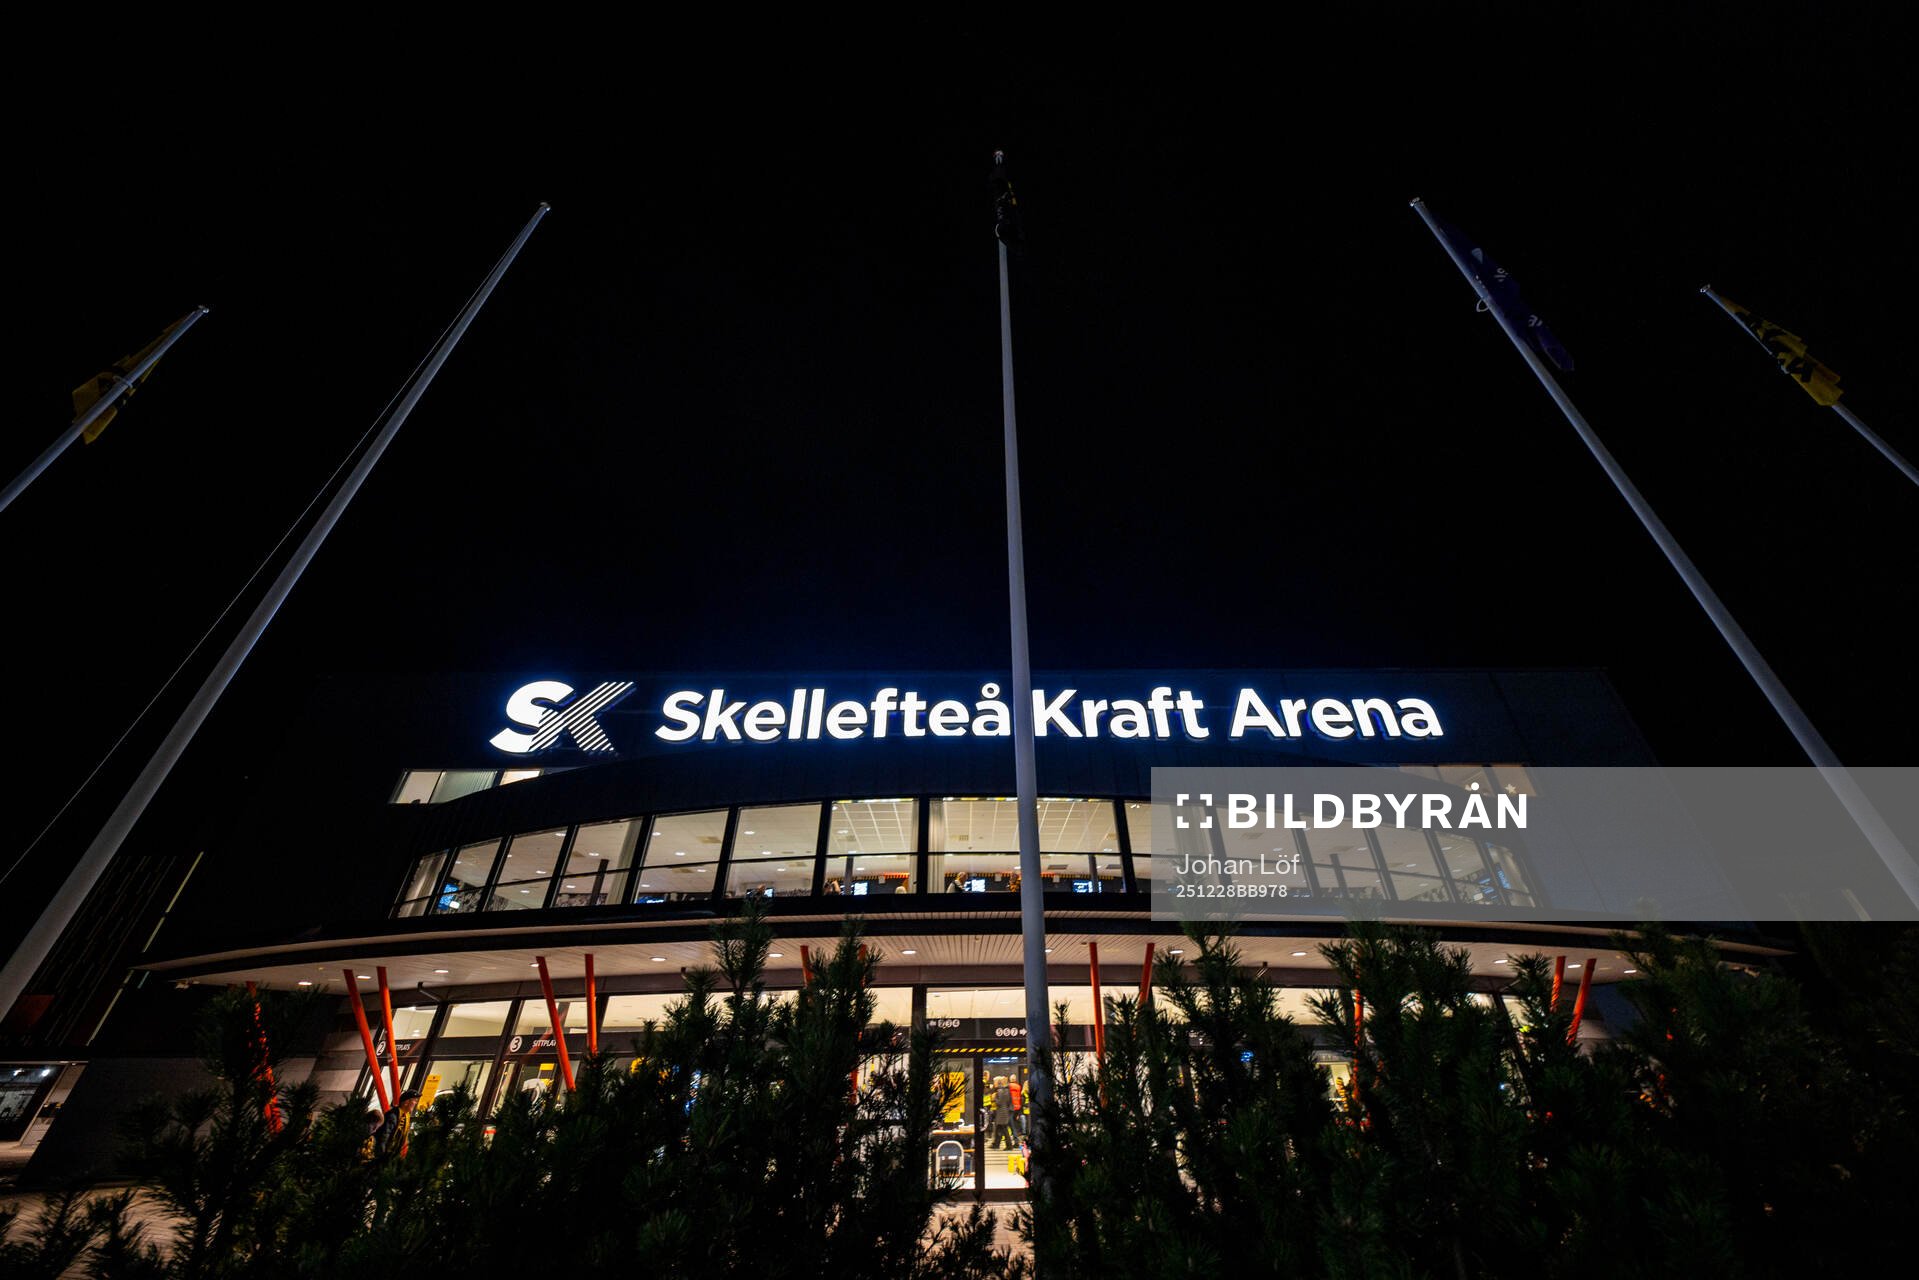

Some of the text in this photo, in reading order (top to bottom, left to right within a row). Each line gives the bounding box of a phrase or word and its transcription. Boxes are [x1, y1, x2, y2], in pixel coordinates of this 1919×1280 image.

[490, 681, 1443, 754] SK Skellefteå Kraft Arena
[531, 1039, 557, 1048] SITTPLAT
